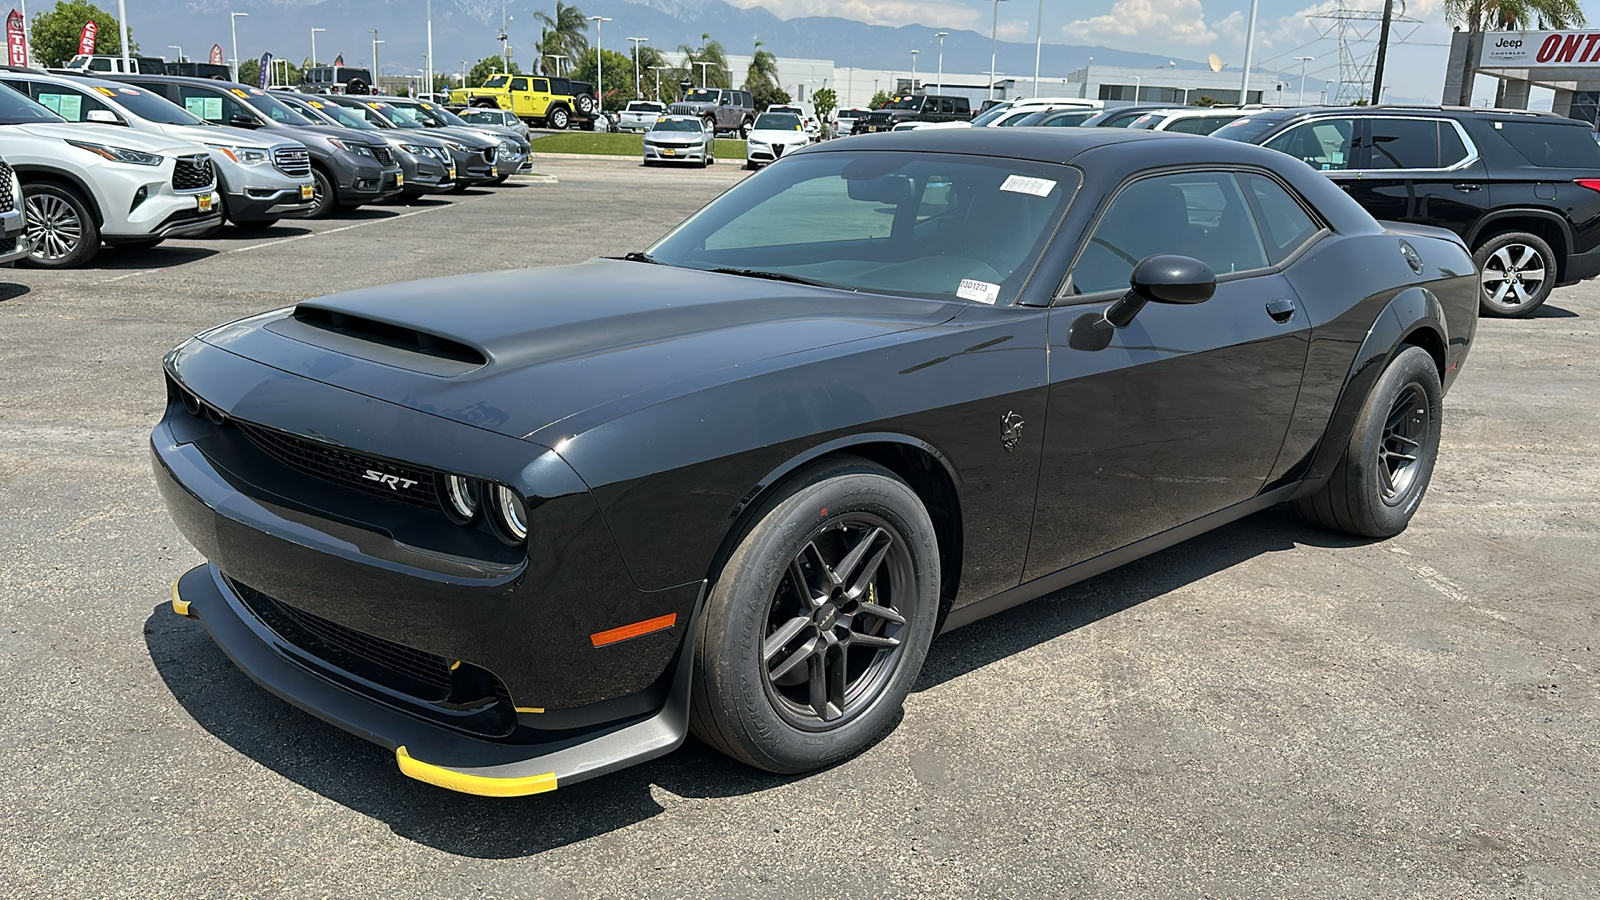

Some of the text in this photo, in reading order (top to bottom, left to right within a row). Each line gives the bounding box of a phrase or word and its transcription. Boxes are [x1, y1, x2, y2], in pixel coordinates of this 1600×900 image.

[12, 35, 25, 67] TRU
[1495, 38, 1523, 49] Jeep
[214, 46, 222, 65] US
[960, 281, 988, 293] 23D1273
[362, 469, 418, 490] SRT
